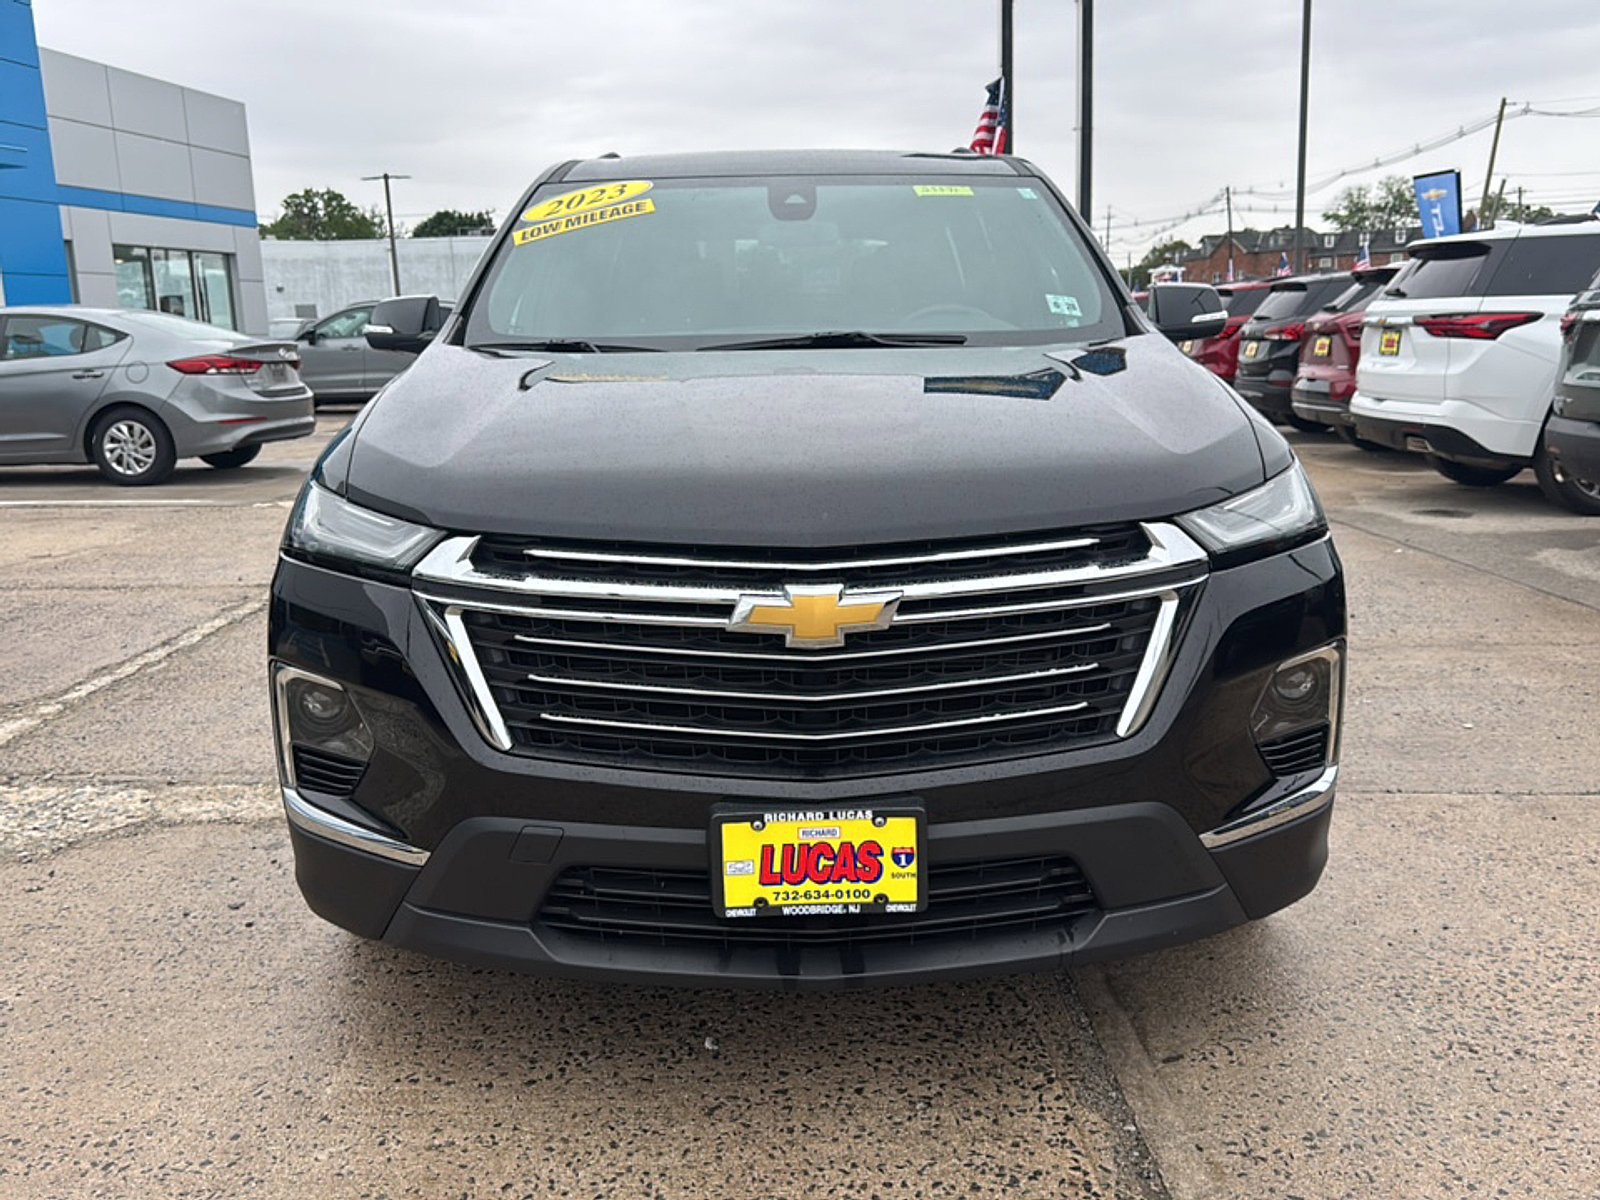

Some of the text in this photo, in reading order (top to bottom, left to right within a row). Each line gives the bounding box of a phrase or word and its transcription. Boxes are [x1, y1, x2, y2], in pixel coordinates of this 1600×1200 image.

[543, 184, 627, 218] 2023
[521, 201, 648, 241] LOW MILEAGE
[764, 810, 873, 823] RICHARD LUCAS
[802, 828, 837, 838] RICHARD
[759, 840, 884, 886] LUCAS
[898, 853, 908, 867] 1
[773, 889, 871, 901] 732-634-0100
[848, 904, 860, 914] NJ
